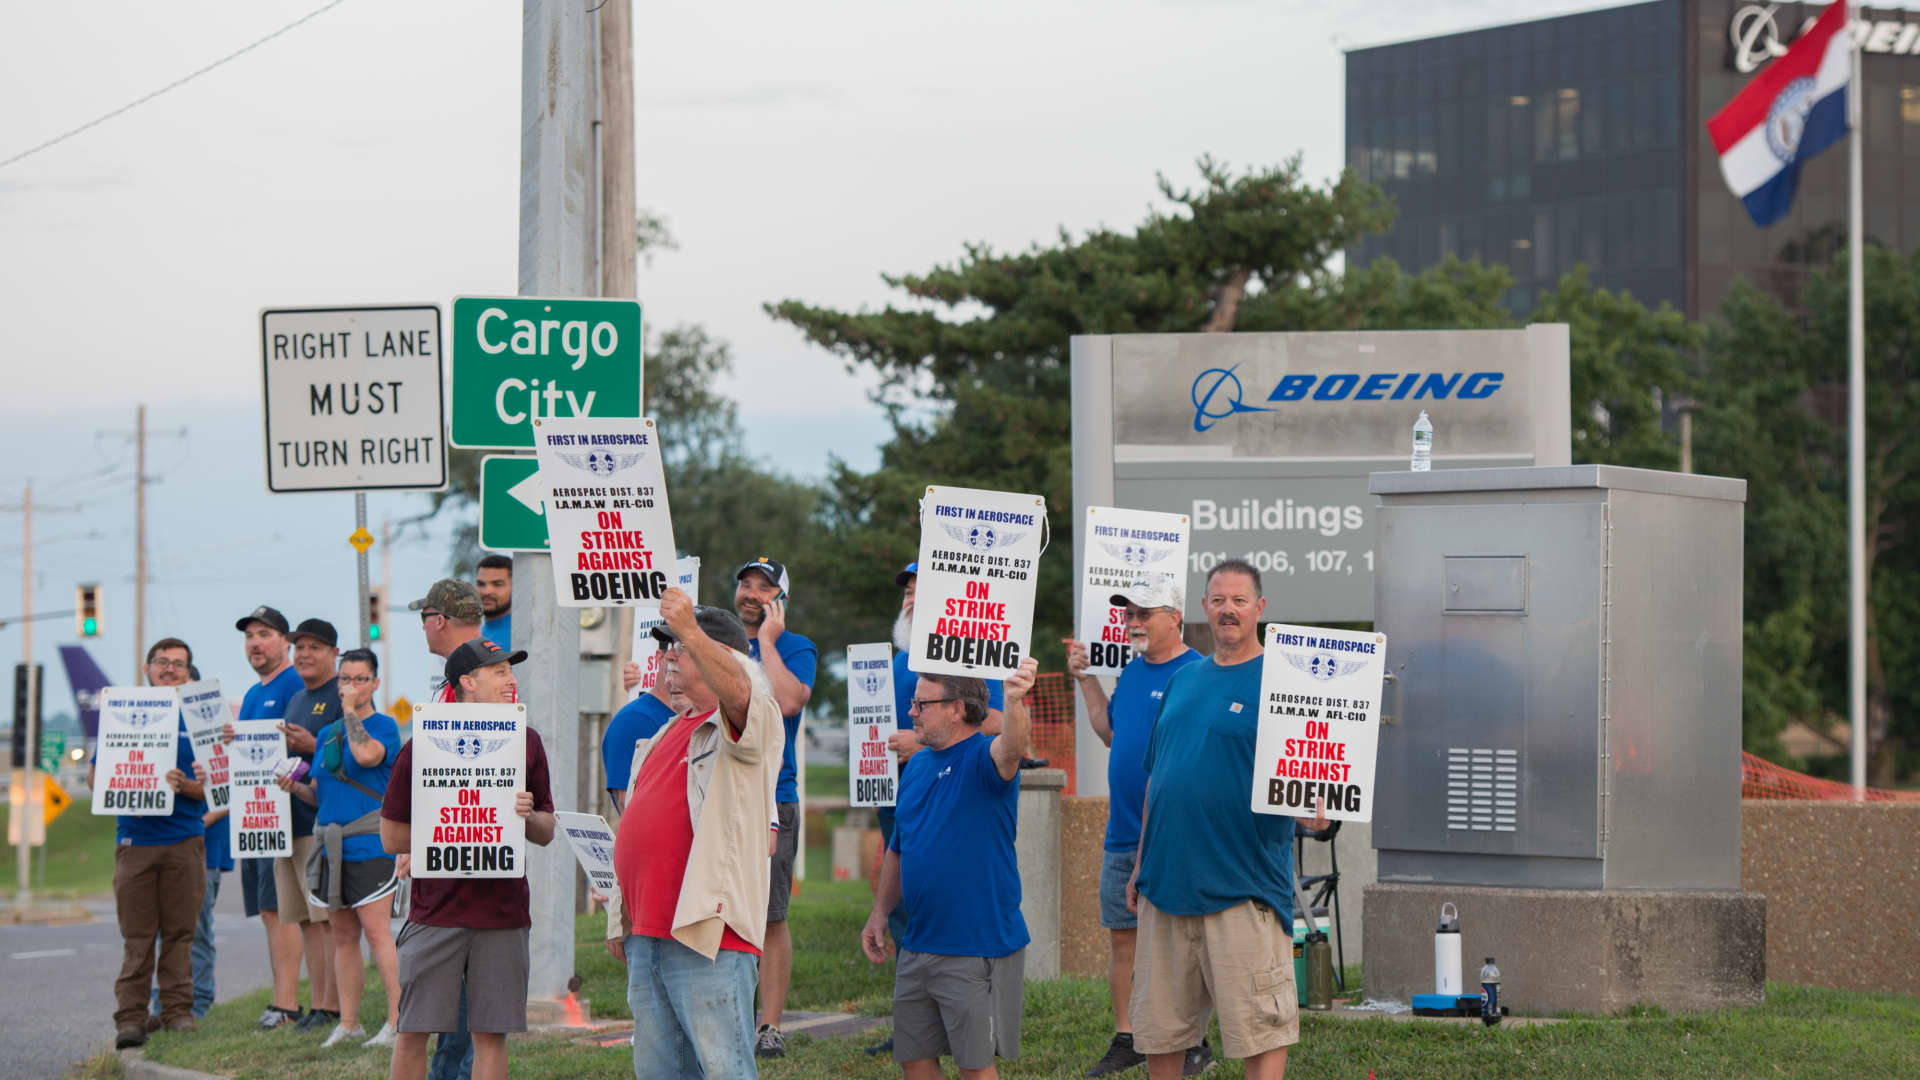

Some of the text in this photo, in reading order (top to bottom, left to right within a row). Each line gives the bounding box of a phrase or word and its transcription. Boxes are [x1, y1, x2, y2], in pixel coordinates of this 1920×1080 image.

[274, 330, 431, 360] RIGHT LANE
[477, 308, 618, 370] Cargo
[1266, 372, 1504, 402] BOEING
[311, 382, 403, 416] MUST
[496, 378, 596, 425] City
[547, 434, 649, 446] FIRST IN AEROSPACE
[279, 437, 433, 467] TURN RIGHT
[552, 487, 654, 497] AEROSPACE DIST. 837
[555, 499, 654, 510] I.A.M.A.W AFL-CIO
[597, 511, 623, 530] ON
[936, 505, 1034, 526] FIRST IN AEROSPACE
[1192, 499, 1363, 536] Buildings
[581, 531, 645, 550] STRIKE
[1094, 525, 1180, 543] FIRST IN AEROSPACE
[578, 552, 653, 571] AGAINST
[932, 550, 1031, 569] AEROSPACE DIST. 837
[1305, 550, 1353, 575] 107,
[932, 562, 1027, 581] I.A.M.A.W AFL-CIO
[1089, 566, 1134, 578] AEROSPACE
[571, 571, 668, 601] BOEING
[965, 580, 990, 600] ON
[1089, 578, 1131, 589] I.A.M.A.W
[945, 598, 1006, 621] STRIKE
[936, 618, 1011, 642] AGAINST
[926, 633, 1020, 669] BOEING
[1276, 633, 1376, 655] FIRST IN AEROSPACE
[1270, 692, 1370, 710] AEROSPACE DIST. 837
[1270, 705, 1367, 721] I.A.M.A.W AFL-CIO
[423, 720, 517, 731] FIRST IN AEROSPACE
[868, 725, 879, 741] ON
[1305, 720, 1329, 740] ON
[128, 750, 145, 762] ON
[861, 742, 886, 758] STRIKE
[1285, 738, 1346, 761] STRIKE
[115, 763, 155, 776] STRIKE
[422, 768, 517, 777] AEROSPACE DIST. 837
[859, 759, 889, 776] AGAINST
[1275, 758, 1351, 782] AGAINST
[109, 777, 159, 789] AGAINST
[254, 786, 266, 799] ON
[423, 779, 514, 788] I.A.M.A.W AFL-CIO
[857, 778, 893, 802] BOEING
[104, 791, 167, 809] BOEING
[458, 789, 480, 806] ON
[1268, 778, 1362, 813] BOEING
[245, 801, 276, 815] STRIKE
[440, 807, 497, 824] STRIKE
[242, 816, 279, 829] AGAINST
[238, 831, 286, 852] BOEING
[432, 826, 504, 843] AGAINST
[426, 846, 514, 872] BOEING
